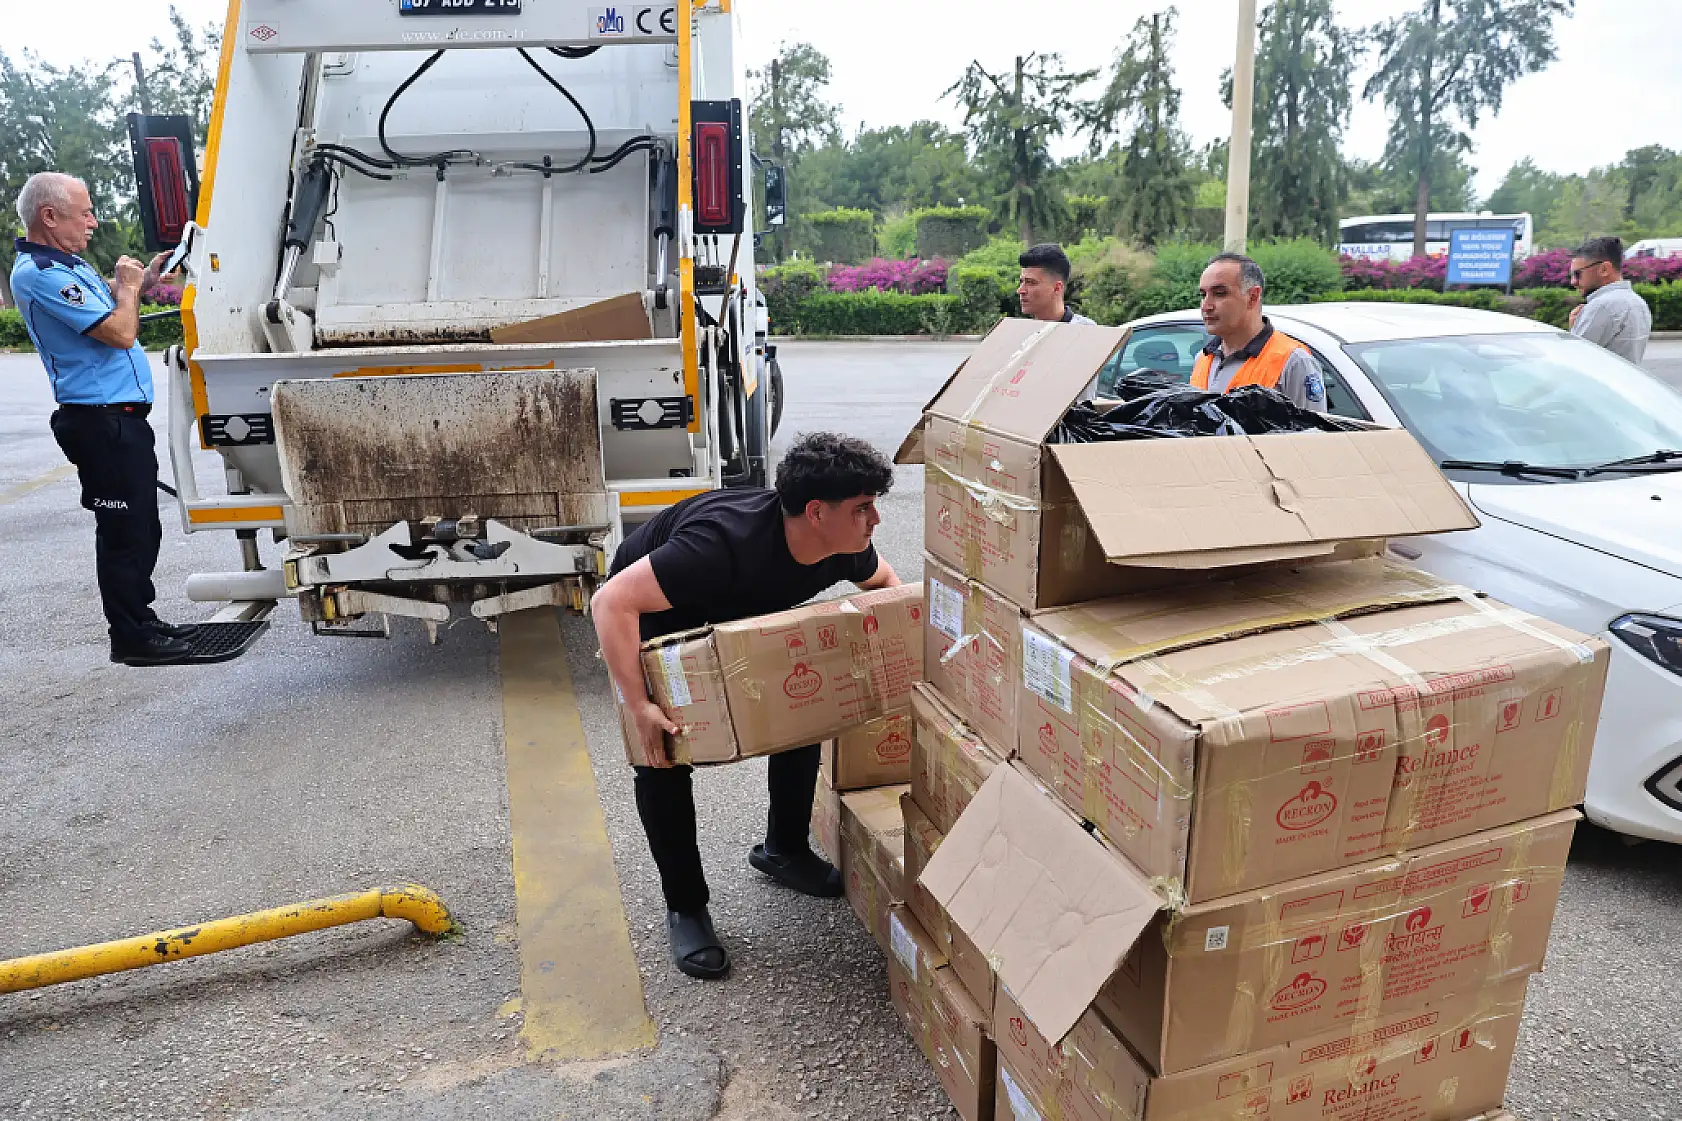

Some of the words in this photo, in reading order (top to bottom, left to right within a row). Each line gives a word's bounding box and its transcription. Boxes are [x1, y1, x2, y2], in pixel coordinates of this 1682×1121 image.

[636, 7, 676, 34] CE
[94, 498, 128, 510] ZABITA
[1396, 743, 1481, 774] Reliance
[1283, 802, 1332, 821] RECRON
